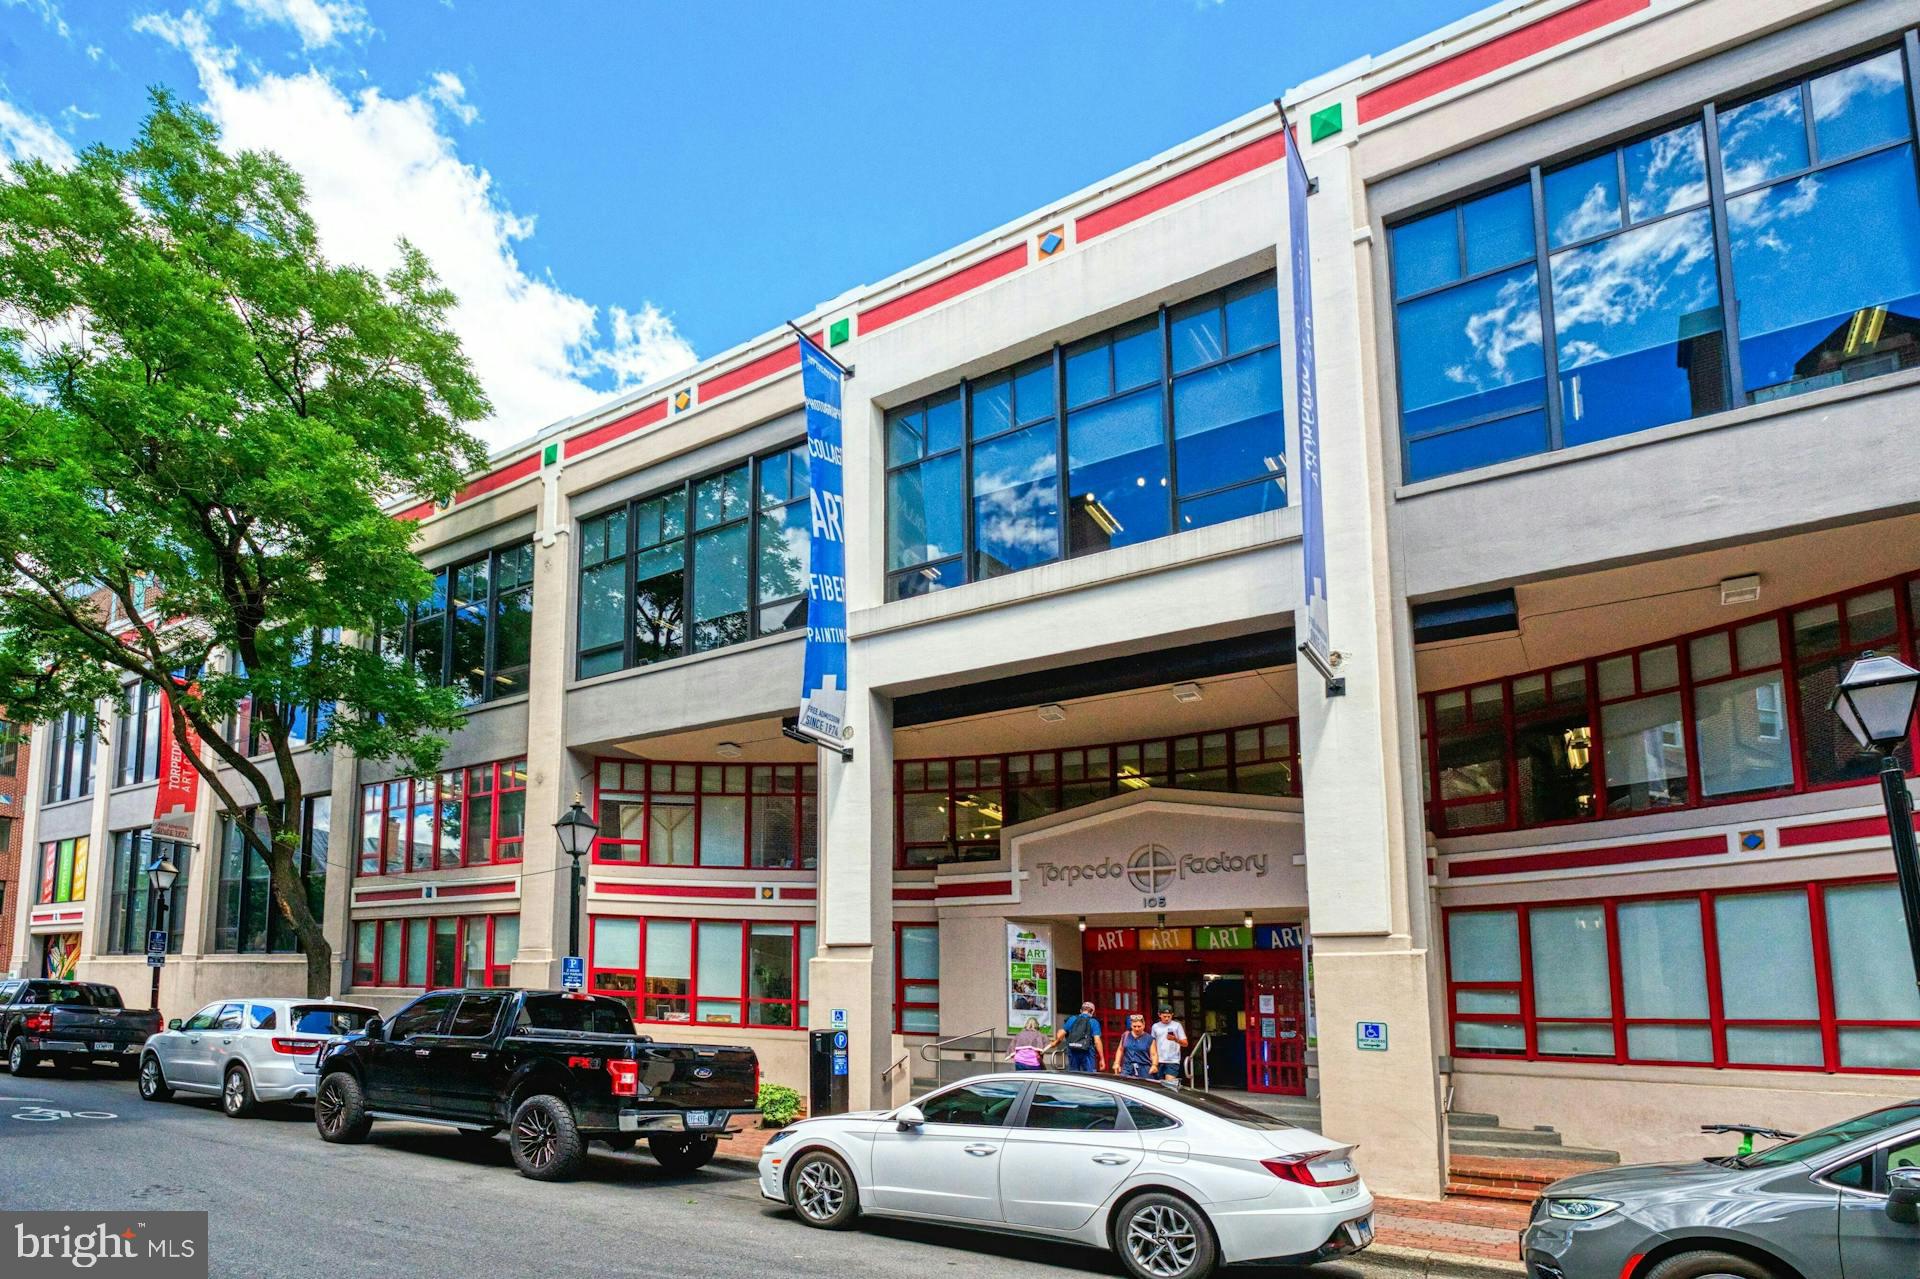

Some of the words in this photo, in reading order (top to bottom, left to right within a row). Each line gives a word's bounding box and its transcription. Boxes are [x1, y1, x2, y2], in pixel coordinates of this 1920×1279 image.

[810, 487, 845, 544] ART
[807, 627, 847, 643] PAINTIN
[805, 715, 824, 731] SINCE
[181, 769, 193, 793] ART
[1036, 857, 1124, 887] Torpedo
[1178, 851, 1269, 878] Factory
[1143, 895, 1167, 908] 105
[1097, 930, 1124, 951] ART
[1151, 929, 1180, 950] ART
[1209, 927, 1239, 949] ART
[1271, 926, 1302, 949] ART
[1026, 949, 1047, 958] ART
[570, 960, 577, 968] P
[838, 1034, 845, 1046] P
[568, 1055, 601, 1069] FX4
